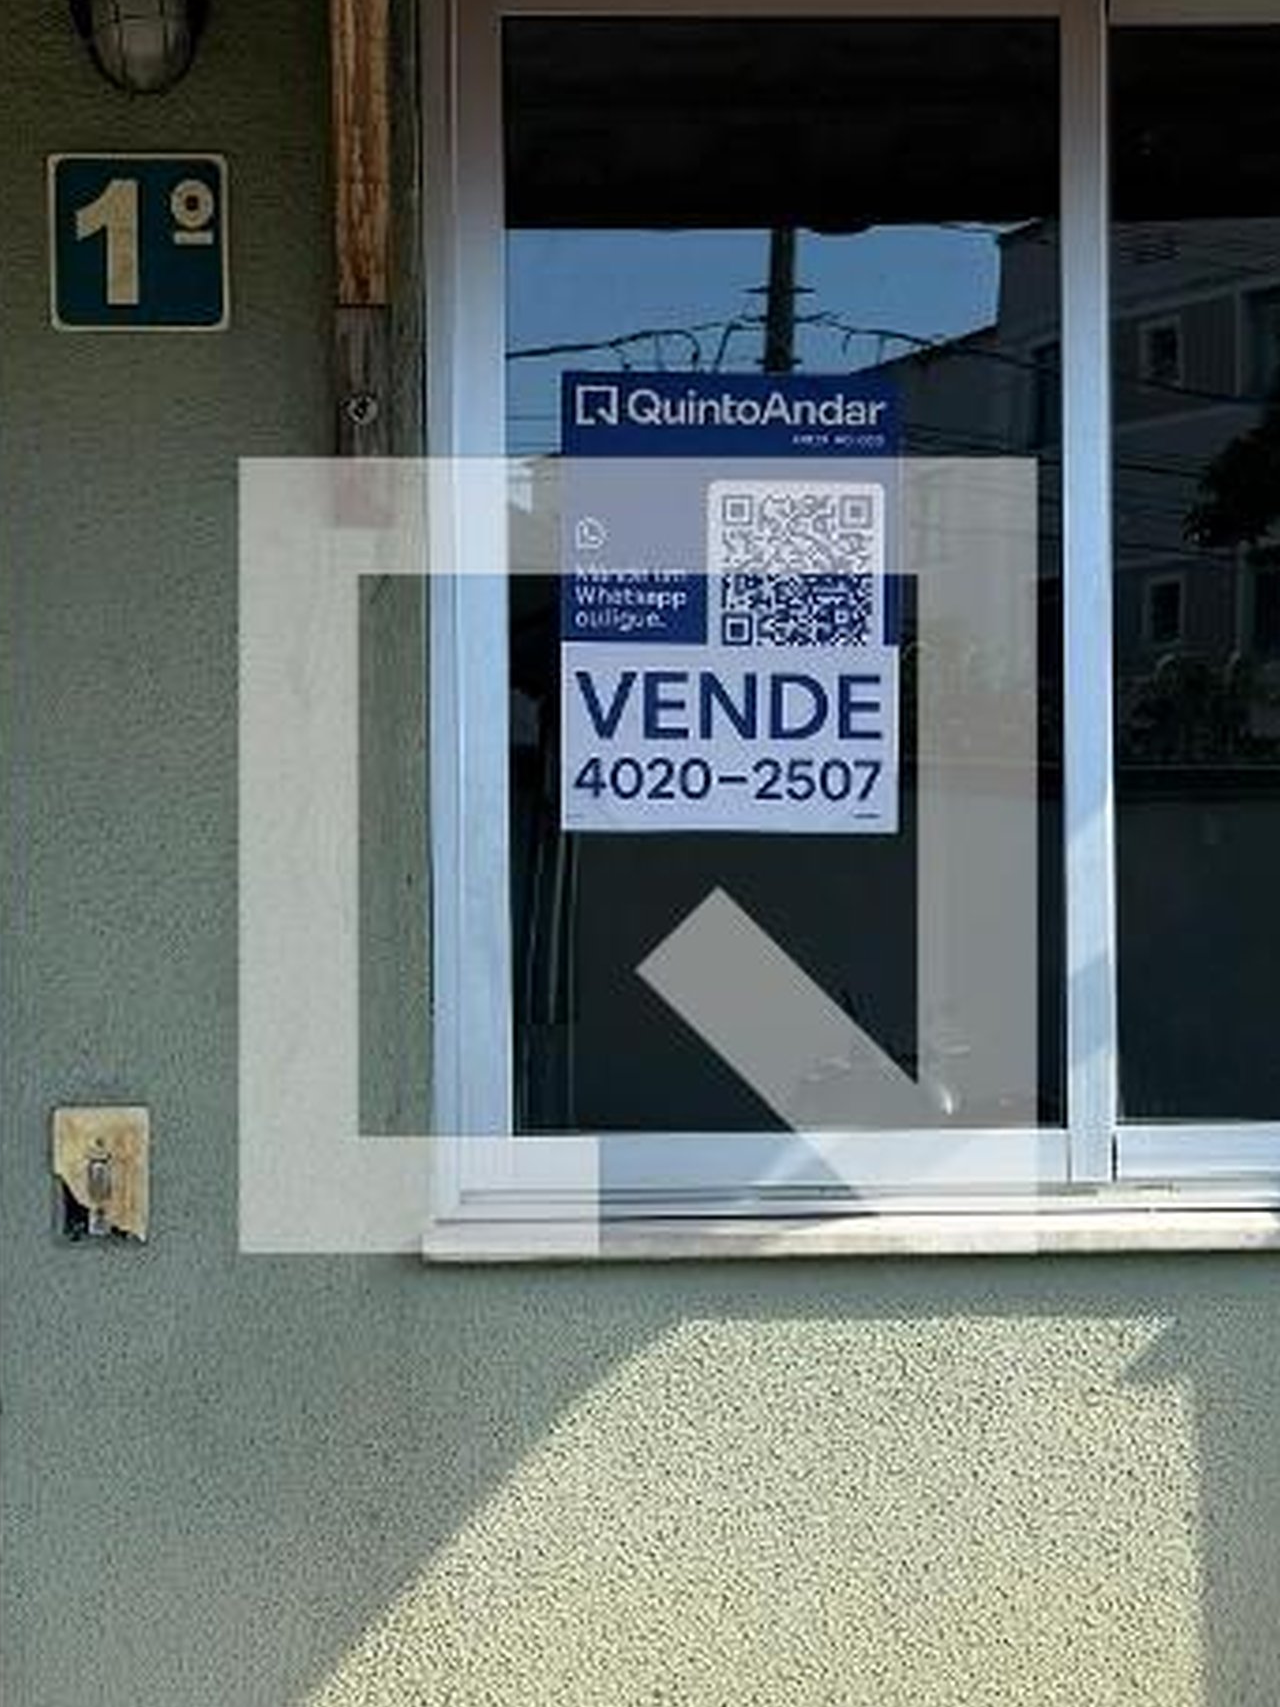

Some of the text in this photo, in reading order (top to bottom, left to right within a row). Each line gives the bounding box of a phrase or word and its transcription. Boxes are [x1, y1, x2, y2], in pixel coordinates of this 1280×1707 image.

[75, 178, 215, 306] 1º
[626, 388, 887, 426] QuintoAndar
[575, 670, 883, 740] VENDE
[573, 756, 882, 801] 4020-2507
